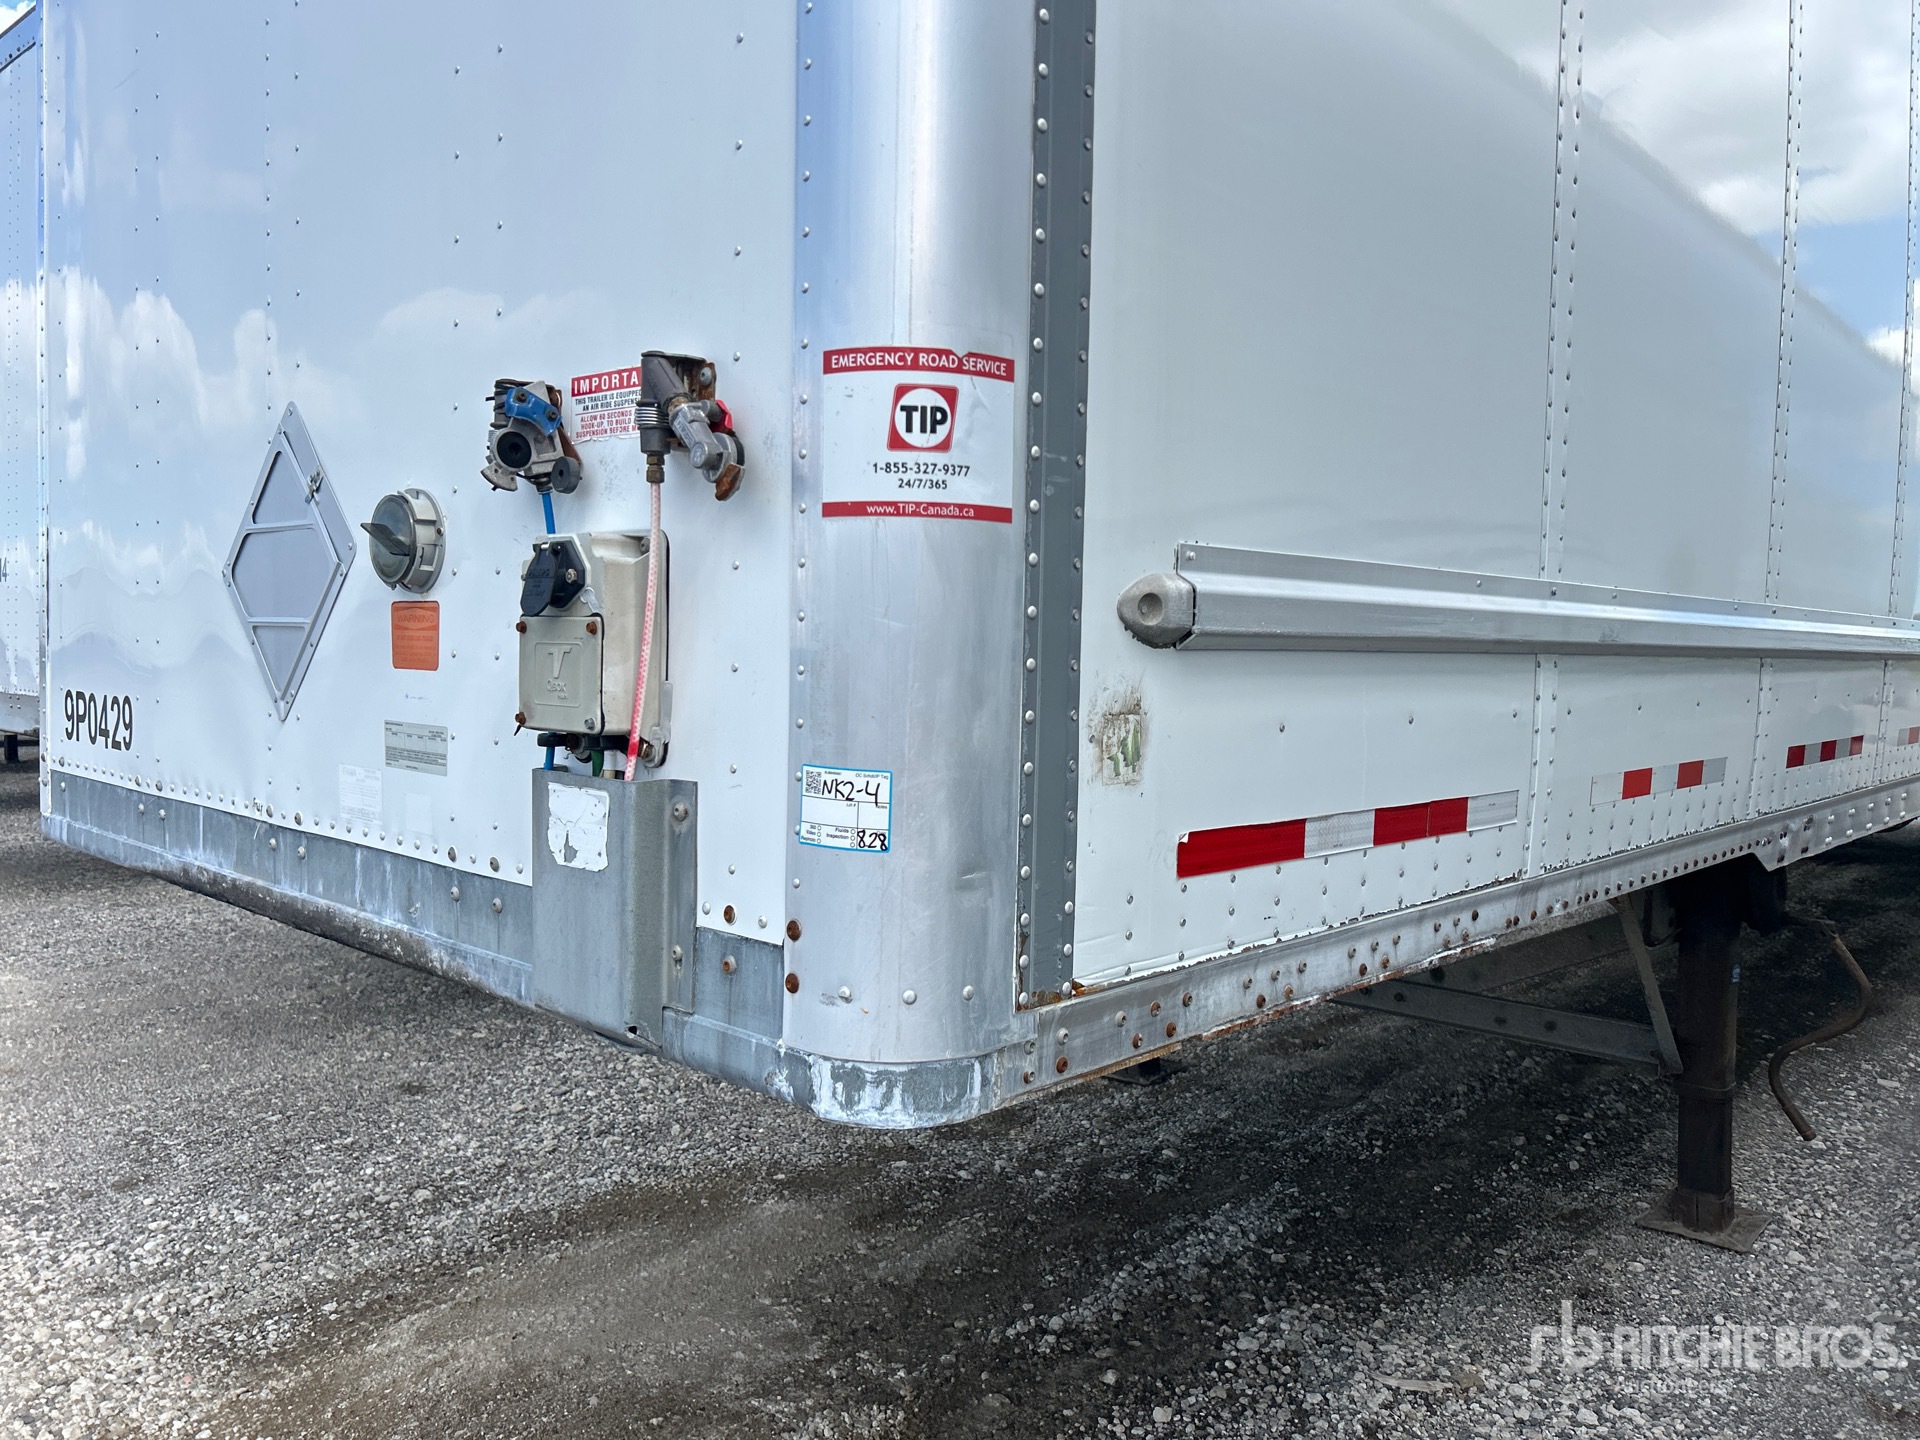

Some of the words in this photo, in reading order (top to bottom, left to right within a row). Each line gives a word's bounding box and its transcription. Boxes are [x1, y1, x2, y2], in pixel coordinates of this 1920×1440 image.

[832, 352, 914, 368] EMERGENCY
[919, 353, 958, 368] ROAD
[962, 356, 1007, 376] SERVICE
[574, 371, 639, 394] IMPORTA
[575, 397, 587, 405] THIS
[587, 394, 608, 403] TRAILER
[600, 401, 612, 409] RIDE
[581, 414, 598, 422] ALLOW
[607, 410, 632, 419] SECONDS
[615, 418, 632, 426] BUILD
[900, 405, 948, 434] TIP
[576, 428, 608, 438] SUSPENSION
[610, 425, 630, 434] BEFORE
[872, 462, 971, 477] 1-855-327-9377
[898, 478, 948, 490] 24/7/365
[866, 503, 975, 517] www.TIP-Canada.ca
[398, 614, 435, 623] WARNING
[64, 689, 133, 751] 9P0429
[822, 778, 881, 807] NK2-4
[857, 829, 888, 851] 828
